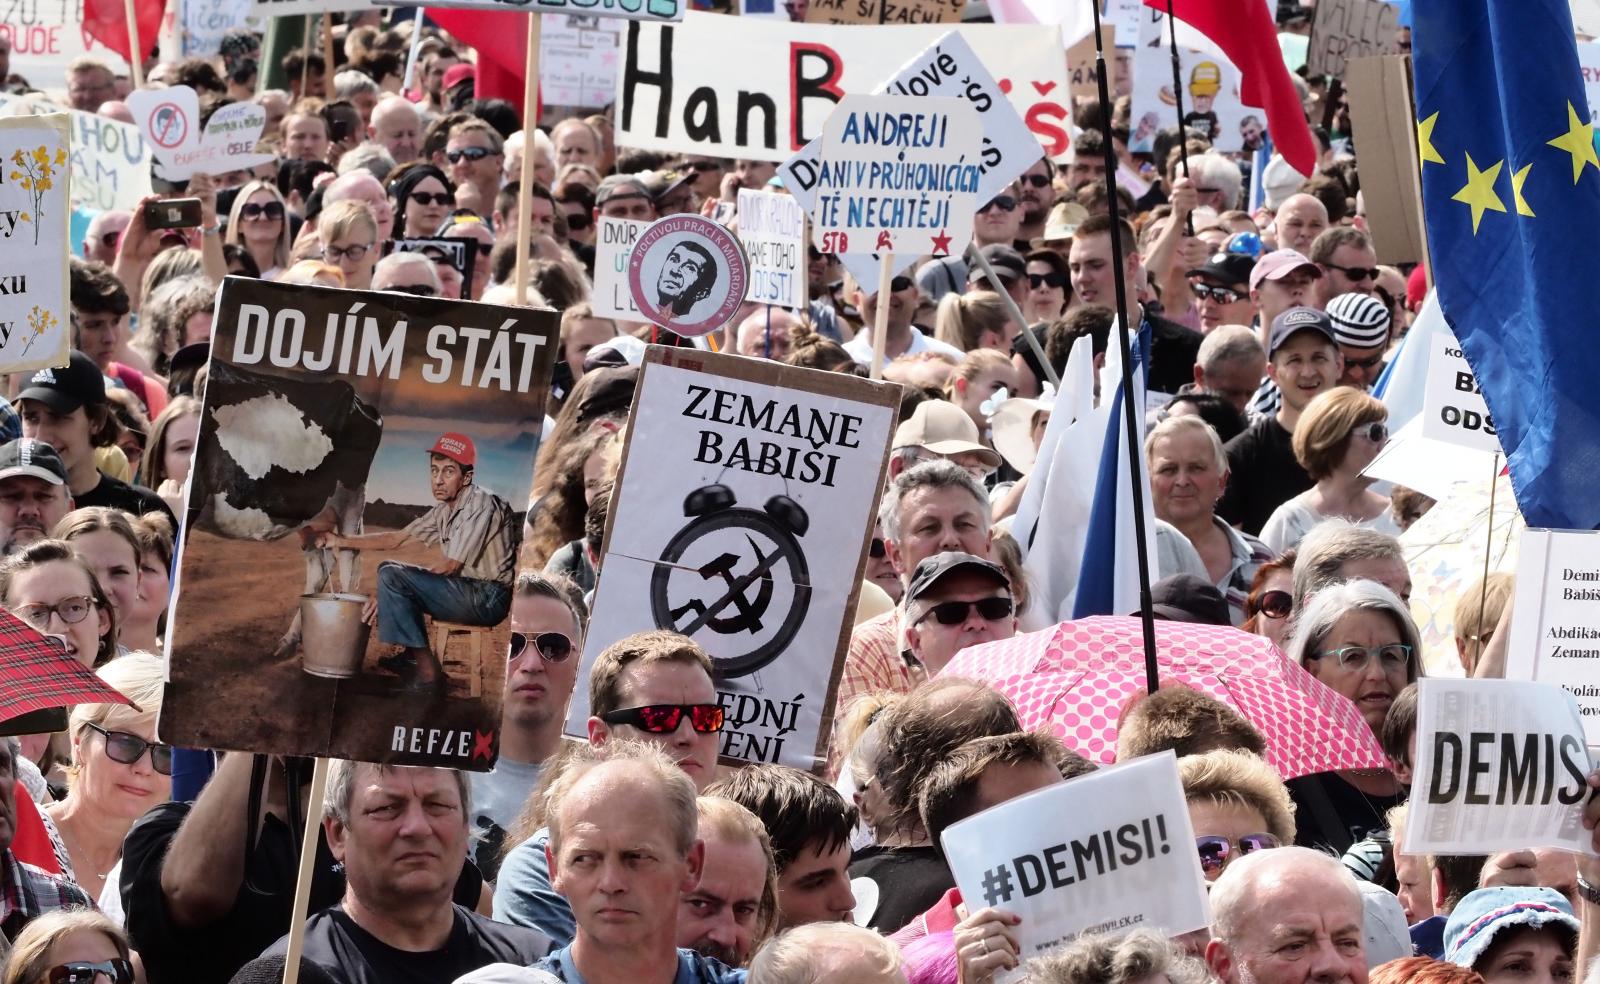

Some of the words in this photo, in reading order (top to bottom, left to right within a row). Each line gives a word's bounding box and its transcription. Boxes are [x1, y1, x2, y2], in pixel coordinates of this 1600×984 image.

[841, 112, 948, 148] ANDREJI
[817, 159, 851, 189] ANI
[856, 161, 867, 189] V
[869, 151, 981, 193] PRŮHONICÍCH
[847, 192, 953, 229] NECHTĚJÍ
[636, 221, 680, 257] POCTIVOU
[684, 221, 713, 239] PRACÍ
[715, 235, 724, 246] K
[232, 302, 408, 380] DOJÍM
[422, 318, 548, 393] STÁT
[681, 384, 863, 449] ZEMANE
[693, 430, 841, 488] BABIŠI
[391, 725, 494, 760] REFLEX
[981, 814, 1171, 907] #DEMISI!
